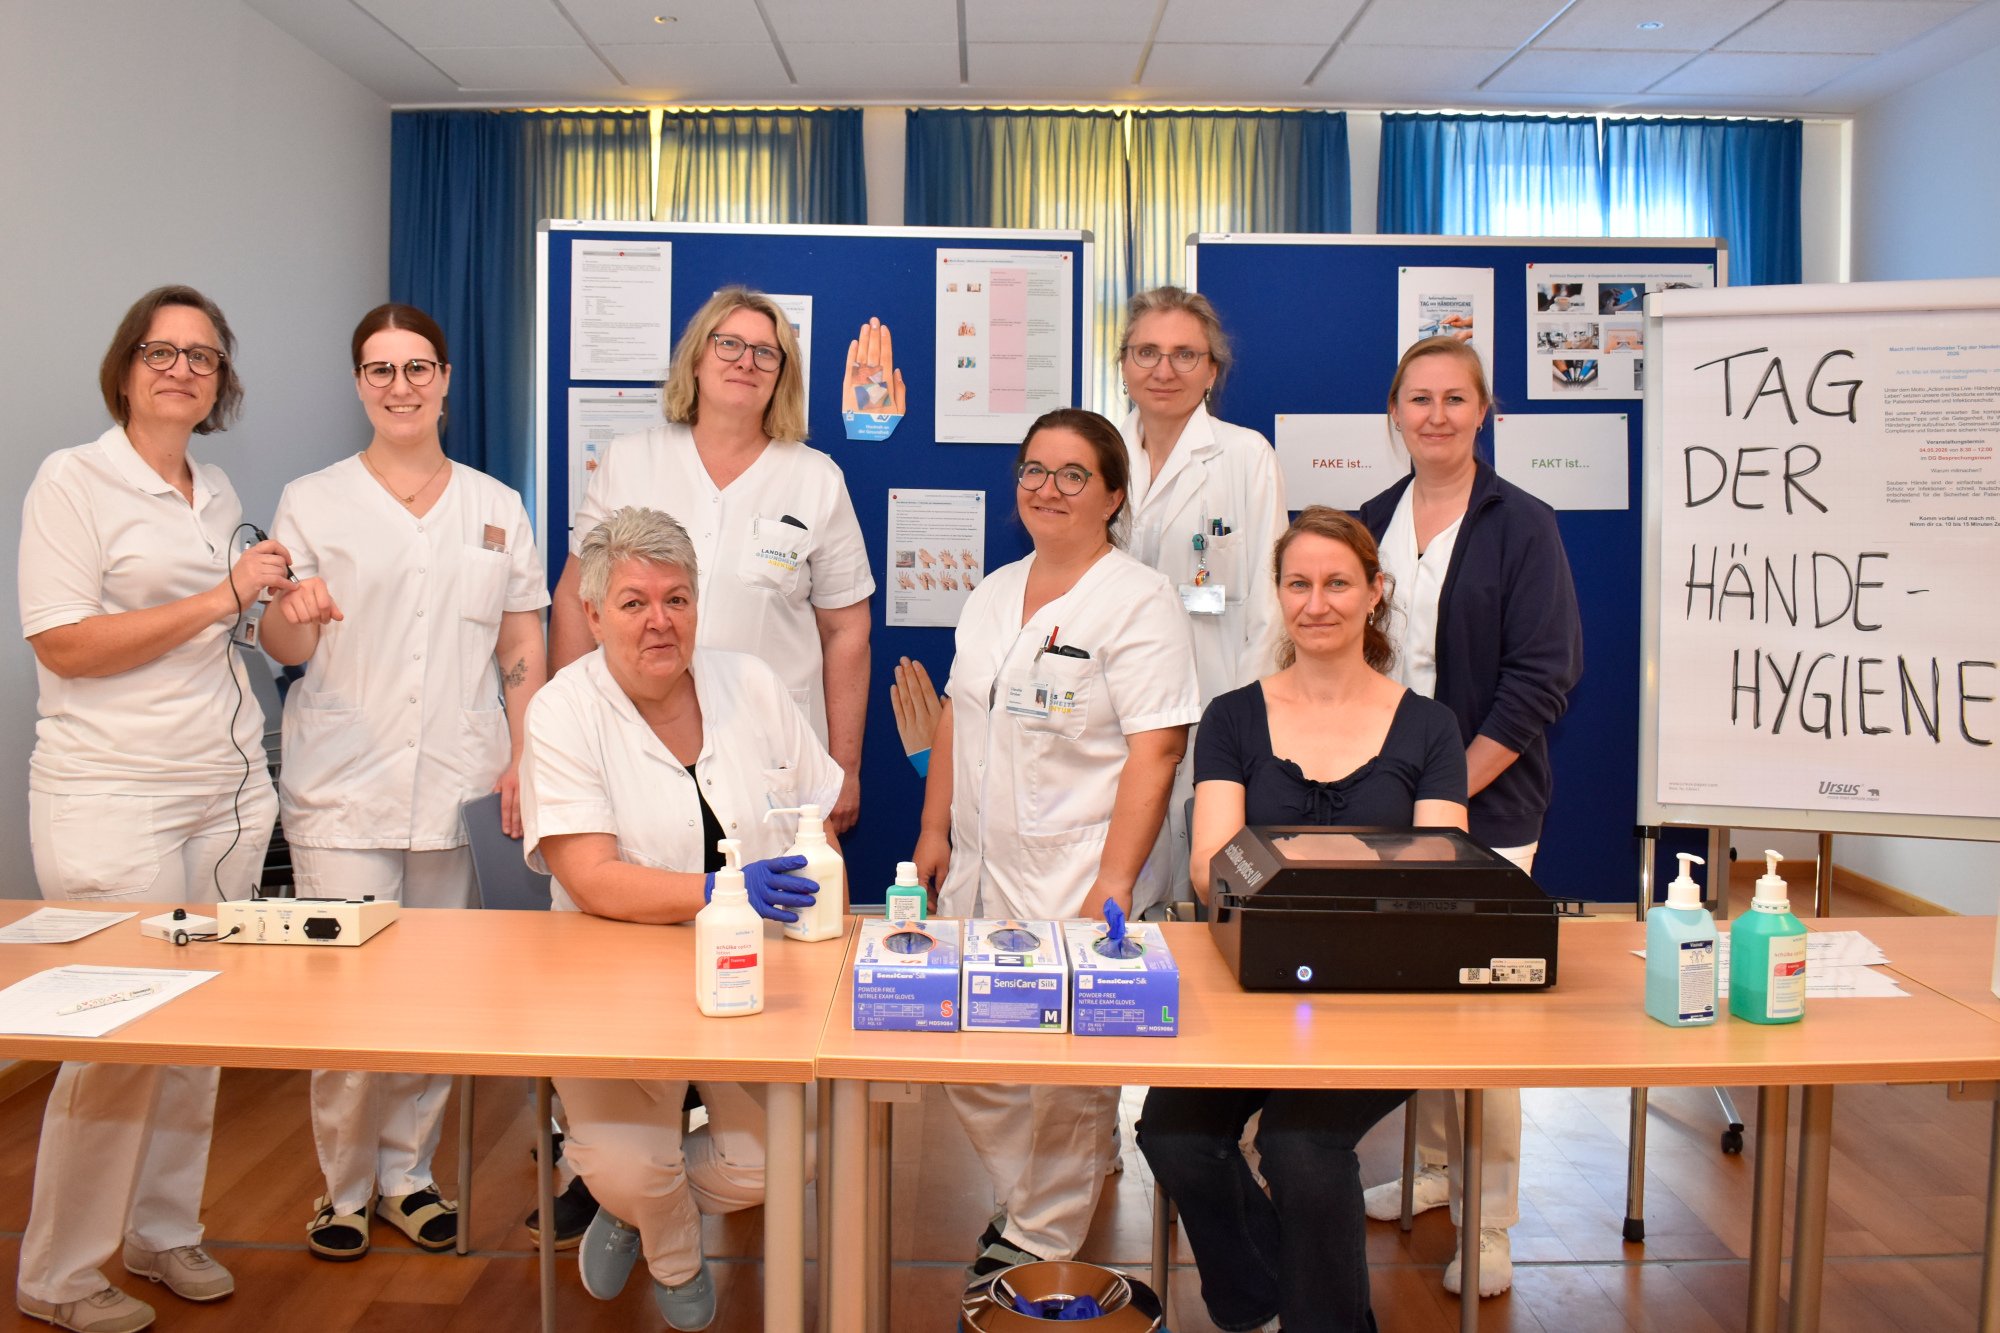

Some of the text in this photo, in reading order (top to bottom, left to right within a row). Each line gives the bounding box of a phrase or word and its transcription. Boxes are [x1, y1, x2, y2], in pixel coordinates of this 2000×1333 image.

[1694, 346, 1863, 425] TAG
[1312, 459, 1343, 468] FAKE
[1532, 459, 1562, 468] FAKT
[1684, 444, 1828, 514] DER
[762, 549, 786, 558] LANDES
[1731, 646, 1998, 746] HYGIENE
[1818, 781, 1860, 795] Ursus
[1247, 870, 1264, 887] UV
[994, 979, 1055, 988] SensiCare Silk
[941, 1000, 953, 1017] S
[1162, 1006, 1174, 1023] L
[1045, 1010, 1057, 1023] M
